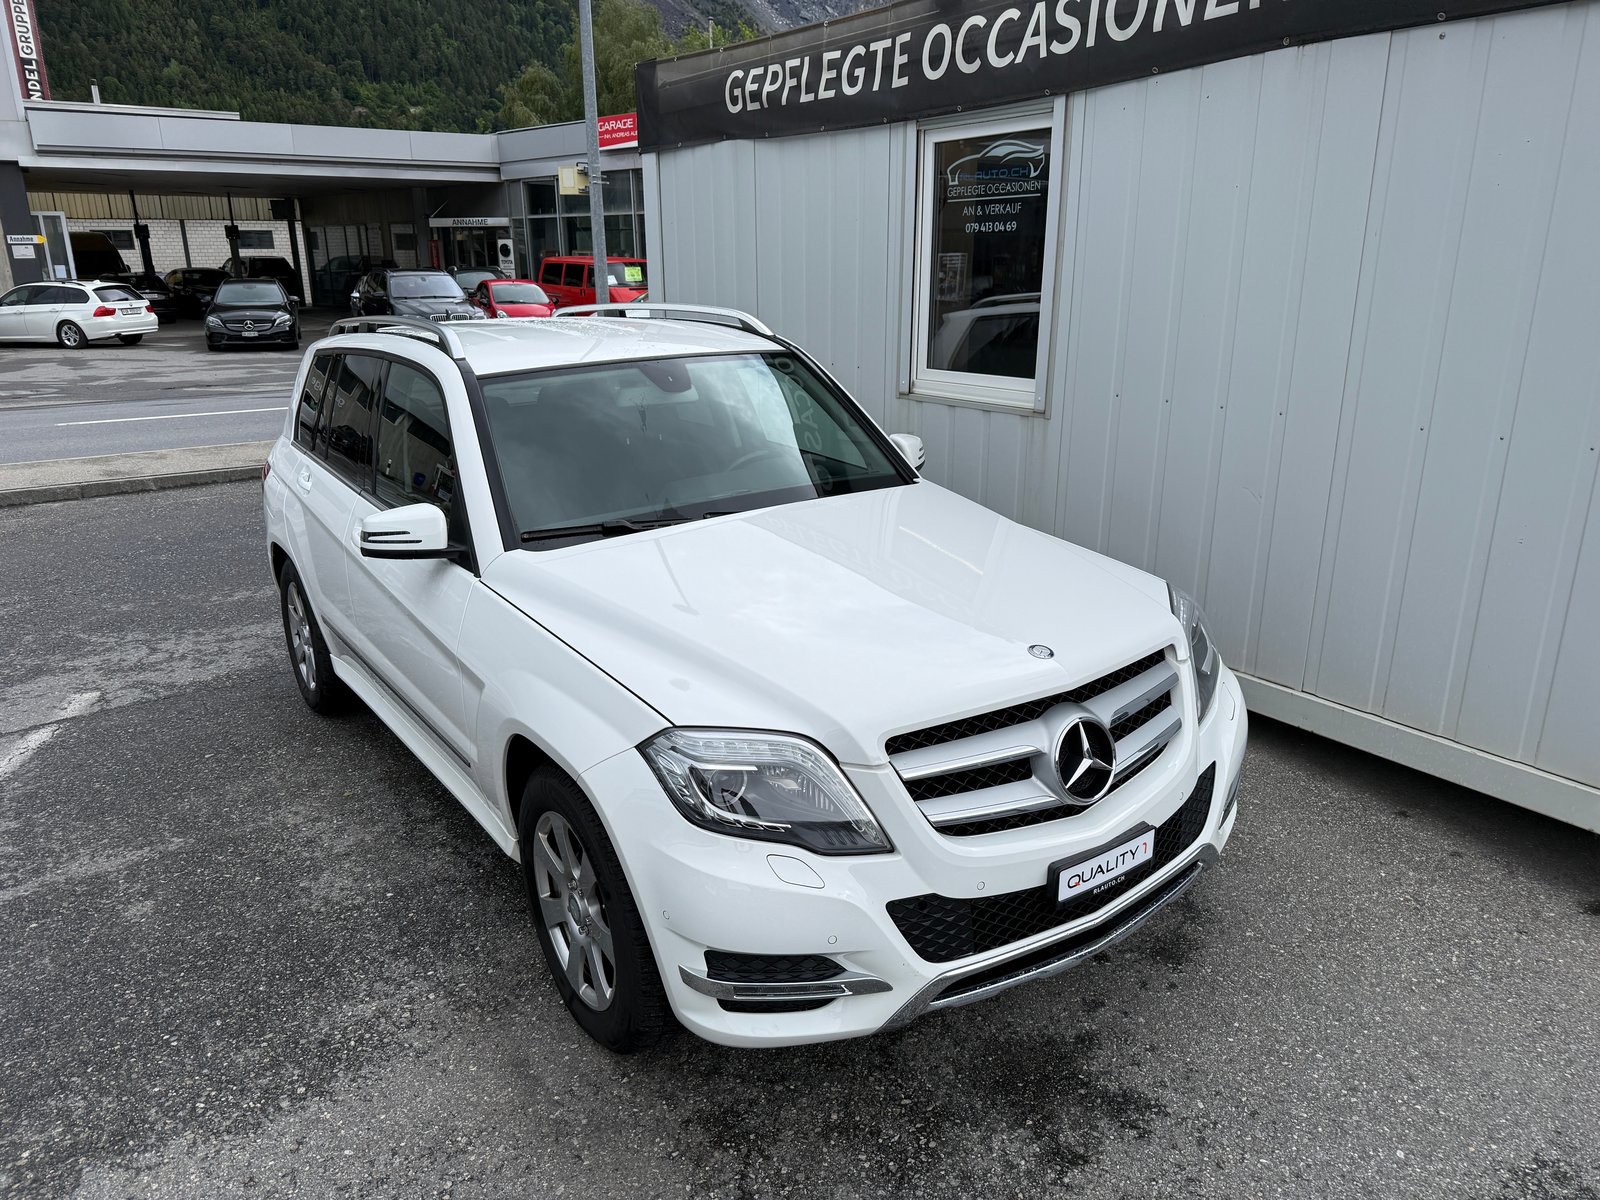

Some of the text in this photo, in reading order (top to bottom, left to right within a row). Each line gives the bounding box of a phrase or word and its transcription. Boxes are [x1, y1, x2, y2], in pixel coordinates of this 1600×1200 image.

[725, 32, 911, 114] GEPFLEGTE
[598, 118, 634, 132] GARAGE
[947, 180, 1041, 197] GEPFLEGTE OCCASIONEN
[962, 202, 1022, 216] AN & VERKAUF
[452, 218, 489, 226] ANNAHME
[965, 220, 1017, 233] 079 413 04 69
[1067, 844, 1140, 889] QUALITY
[1093, 875, 1125, 895] RLAUTO.CH
